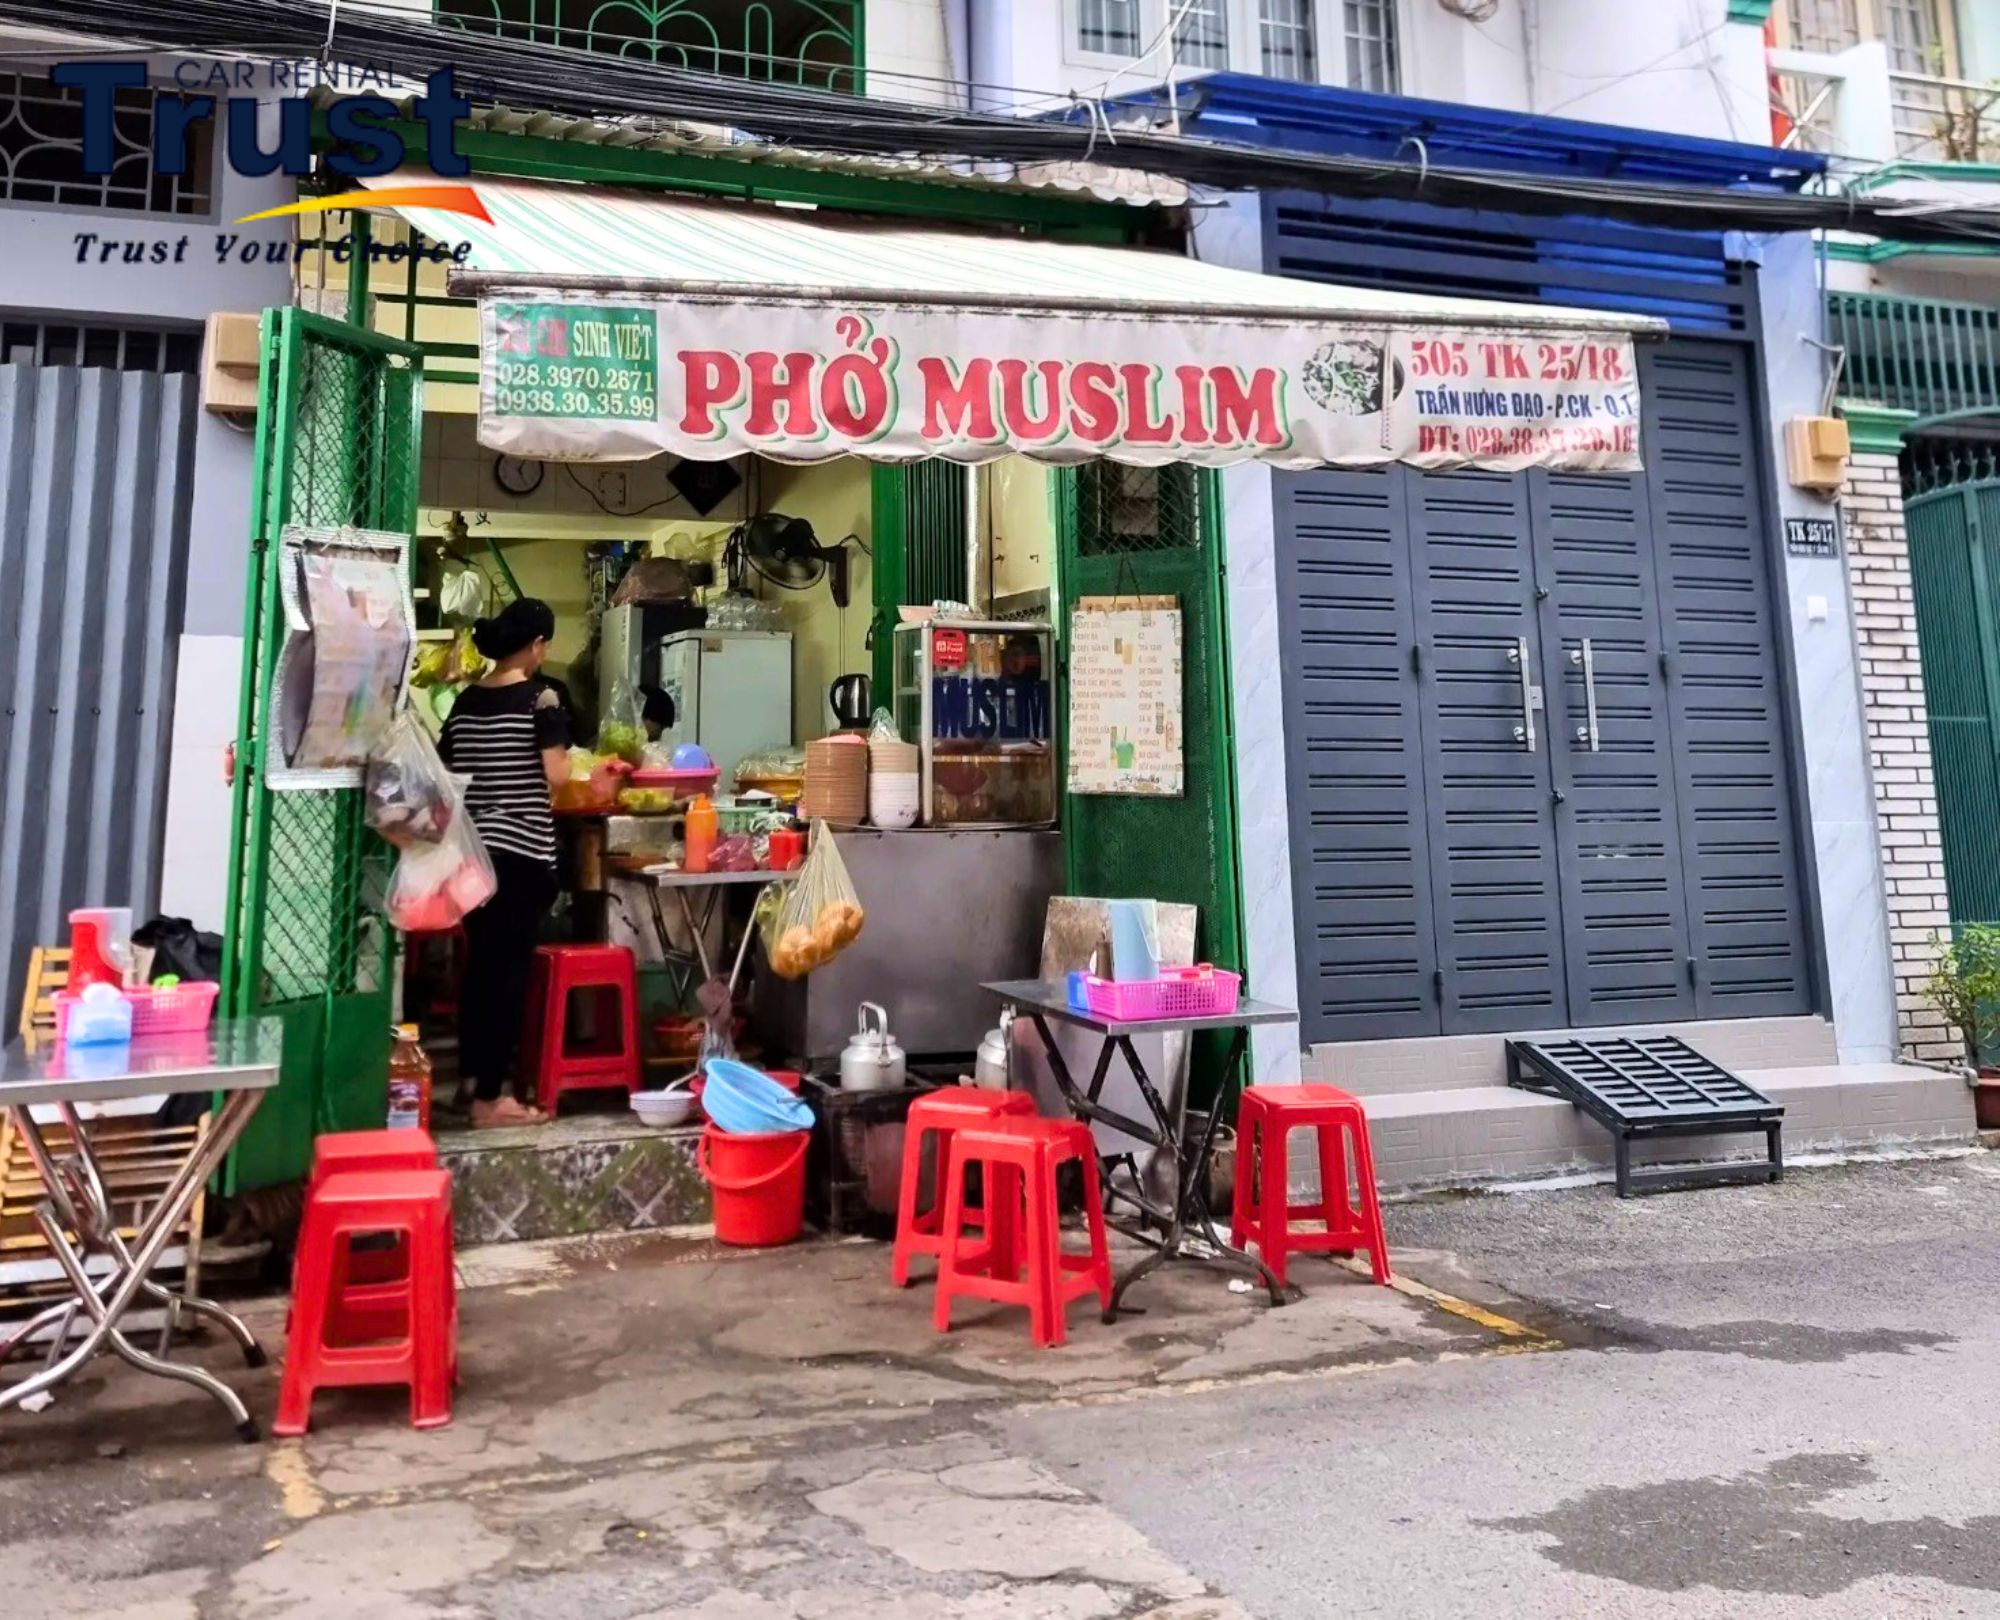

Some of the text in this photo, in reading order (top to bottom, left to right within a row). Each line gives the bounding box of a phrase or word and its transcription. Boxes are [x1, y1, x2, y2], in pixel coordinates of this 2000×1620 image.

[573, 319, 611, 358] SINH
[614, 313, 653, 368] VIỆT
[1411, 340, 1623, 382] 505 TK 25/18
[500, 362, 654, 393] 028.3970.2671
[676, 315, 1286, 447] PHỞ MUSLIM
[500, 388, 655, 418] 0938.30.35.99
[1415, 383, 1461, 416] TRẦN
[1464, 387, 1507, 418] HƯNG
[1512, 391, 1544, 423] ĐẠO
